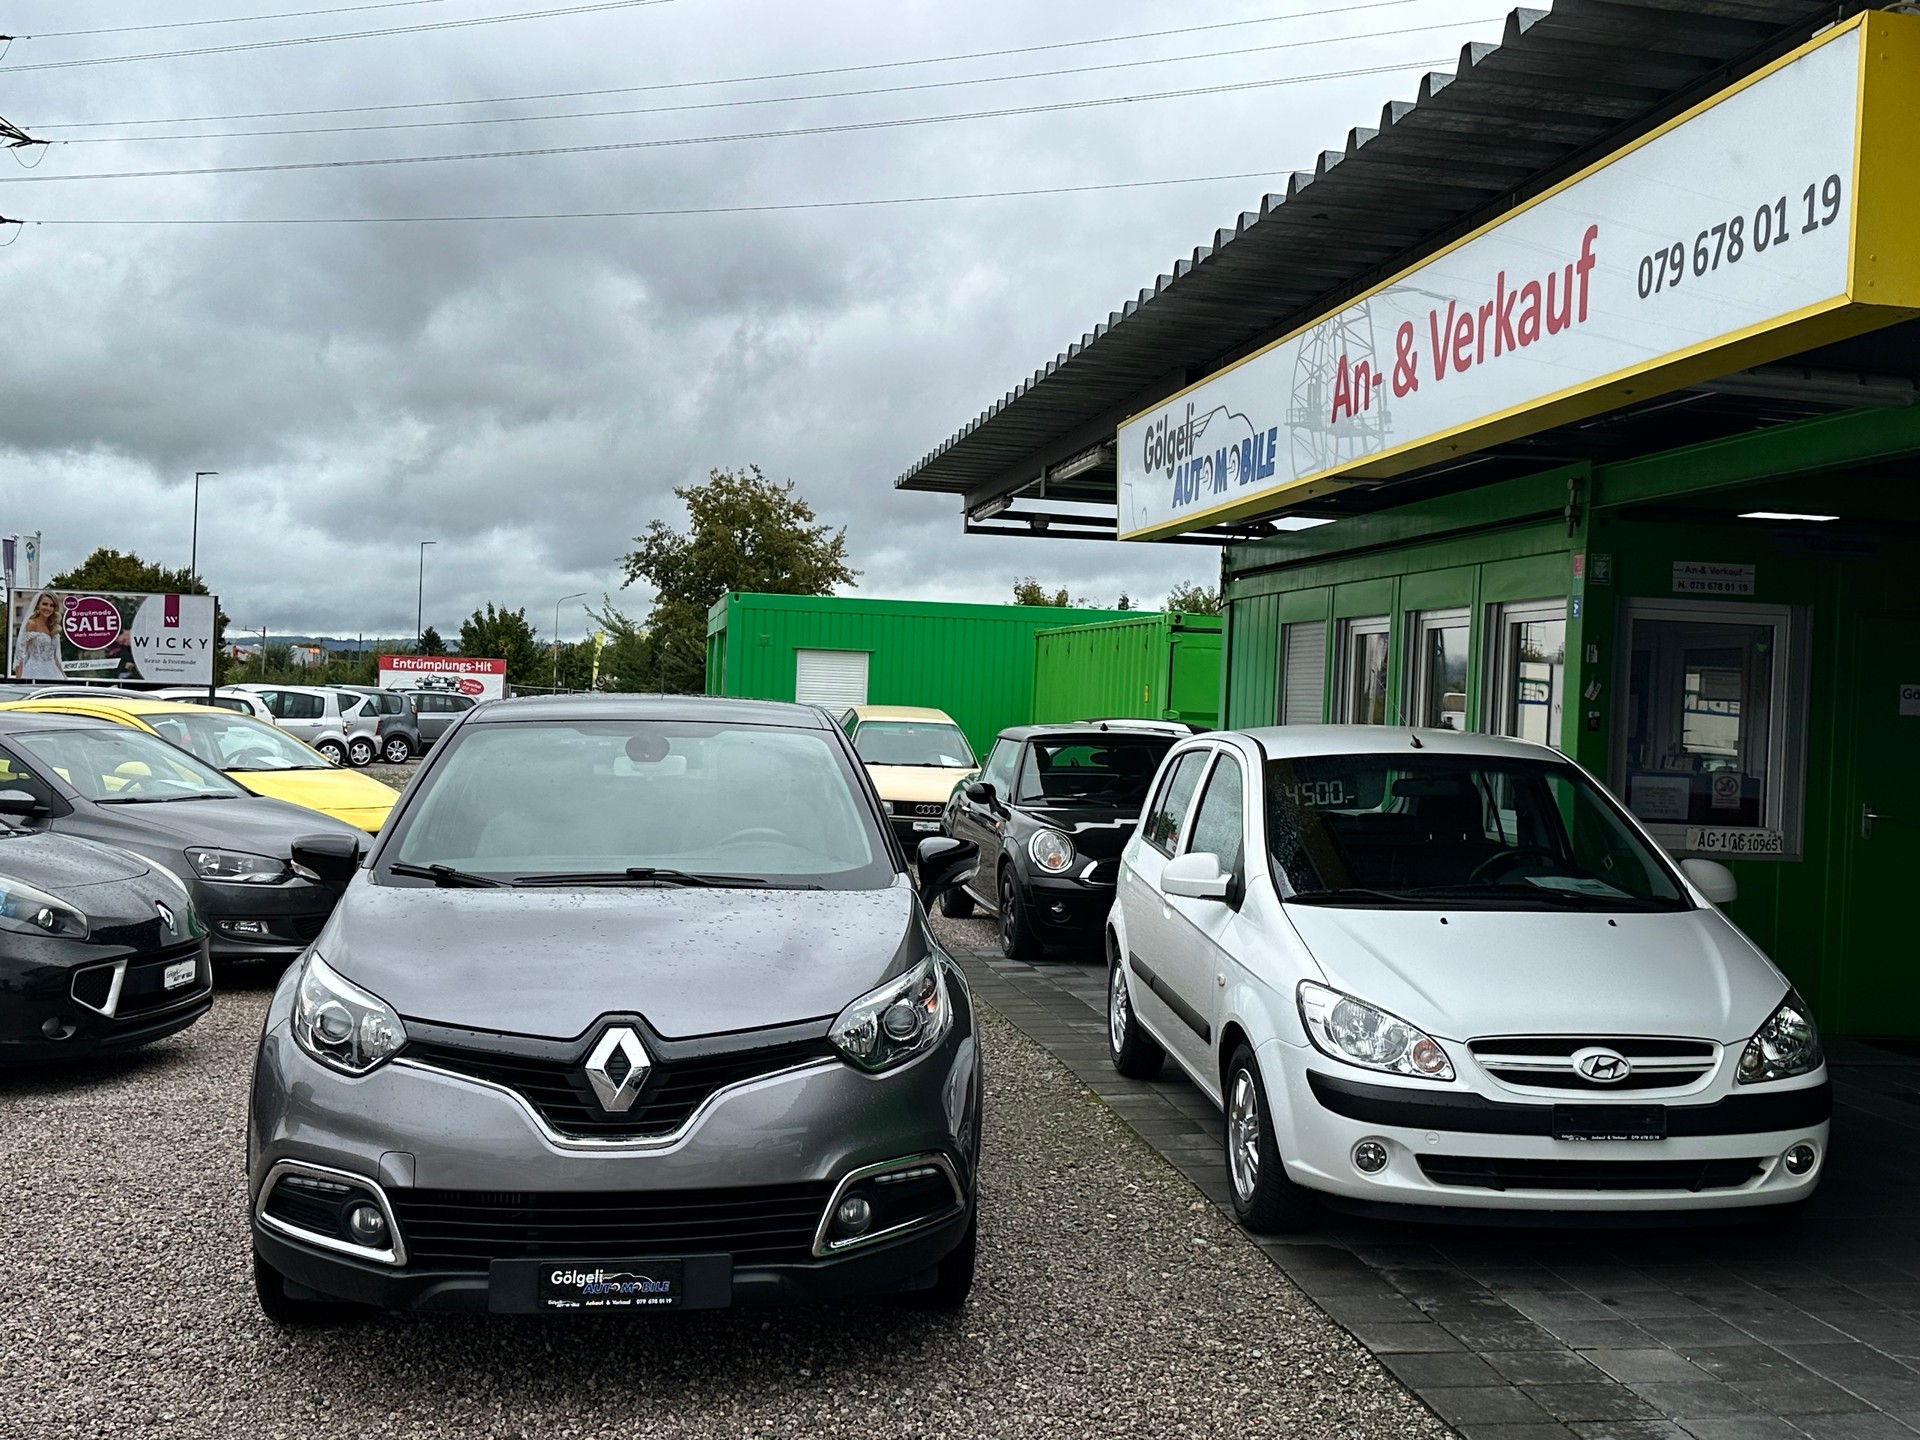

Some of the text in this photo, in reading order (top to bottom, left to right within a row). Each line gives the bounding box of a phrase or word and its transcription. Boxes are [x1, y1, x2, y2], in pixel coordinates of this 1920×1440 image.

[1638, 174, 1841, 299] 079 678 01 19
[1331, 224, 1598, 424] An- & Verkauf
[1143, 402, 1195, 480] Gölgeli
[1172, 426, 1278, 509] AUTOMOBILE
[1709, 567, 1743, 577] Verkauf
[1689, 581, 1706, 590] 079
[1707, 582, 1723, 591] 678
[1725, 583, 1735, 591] 01
[1738, 584, 1748, 592] 19
[66, 615, 118, 632] SALE
[133, 636, 208, 650] WICKY
[392, 658, 493, 673] Entrümplungs-Hit
[551, 1269, 604, 1287] Gölgeli
